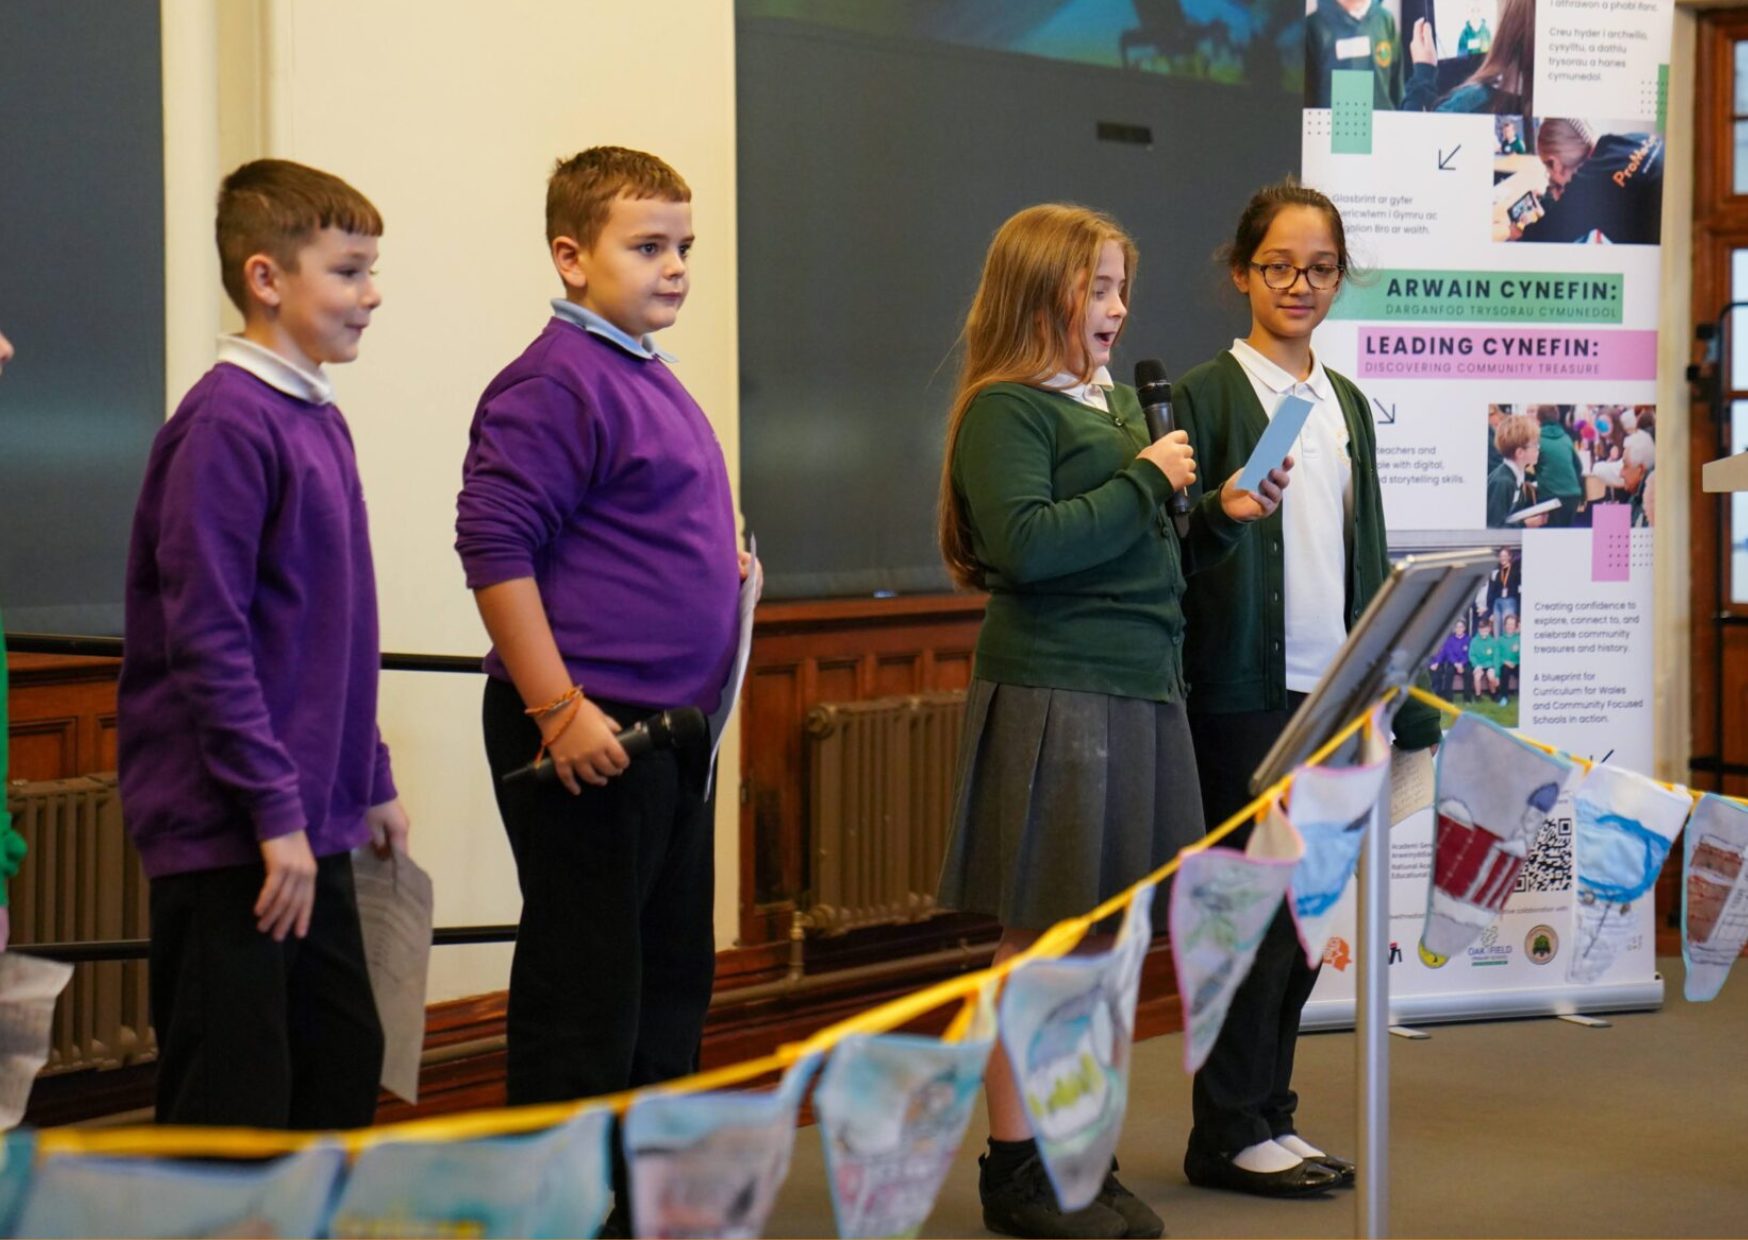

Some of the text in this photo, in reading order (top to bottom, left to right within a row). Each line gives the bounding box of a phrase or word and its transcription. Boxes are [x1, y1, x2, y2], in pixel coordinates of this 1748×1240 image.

[1548, 27, 1572, 37] Creu
[1574, 28, 1600, 39] hyder
[1597, 44, 1627, 54] dathlu
[1548, 57, 1588, 68] trysorau
[1598, 58, 1626, 68] hanes
[1378, 196, 1388, 204] ar
[1390, 195, 1414, 207] gyfer
[1393, 210, 1424, 221] Gymru
[1426, 212, 1438, 220] ac
[1391, 226, 1402, 234] ar
[1386, 277, 1618, 301] ARWAIN CYNEFIN:
[1385, 302, 1617, 318] DARGANFOD TRYSORAU CYMUNEDOL
[1365, 335, 1599, 357] LEADING CYNEFIN:
[1364, 361, 1600, 375] DISCOVERING COMMUNITY TREASURE
[1418, 446, 1437, 455] and
[1393, 460, 1412, 470] with
[1389, 475, 1440, 487] storytelling
[1534, 601, 1637, 613] Creating confidence to
[1570, 615, 1609, 625] connect
[1623, 614, 1641, 624] and
[1534, 629, 1631, 640] celebrate community
[1534, 644, 1575, 654] treasures
[1577, 643, 1596, 653] and
[1533, 671, 1596, 684] A blueprint for
[1532, 684, 1627, 696] Curriculum for Wales
[1532, 698, 1644, 711] and Community Focused
[1532, 714, 1568, 725] Schools
[1569, 713, 1578, 723] in
